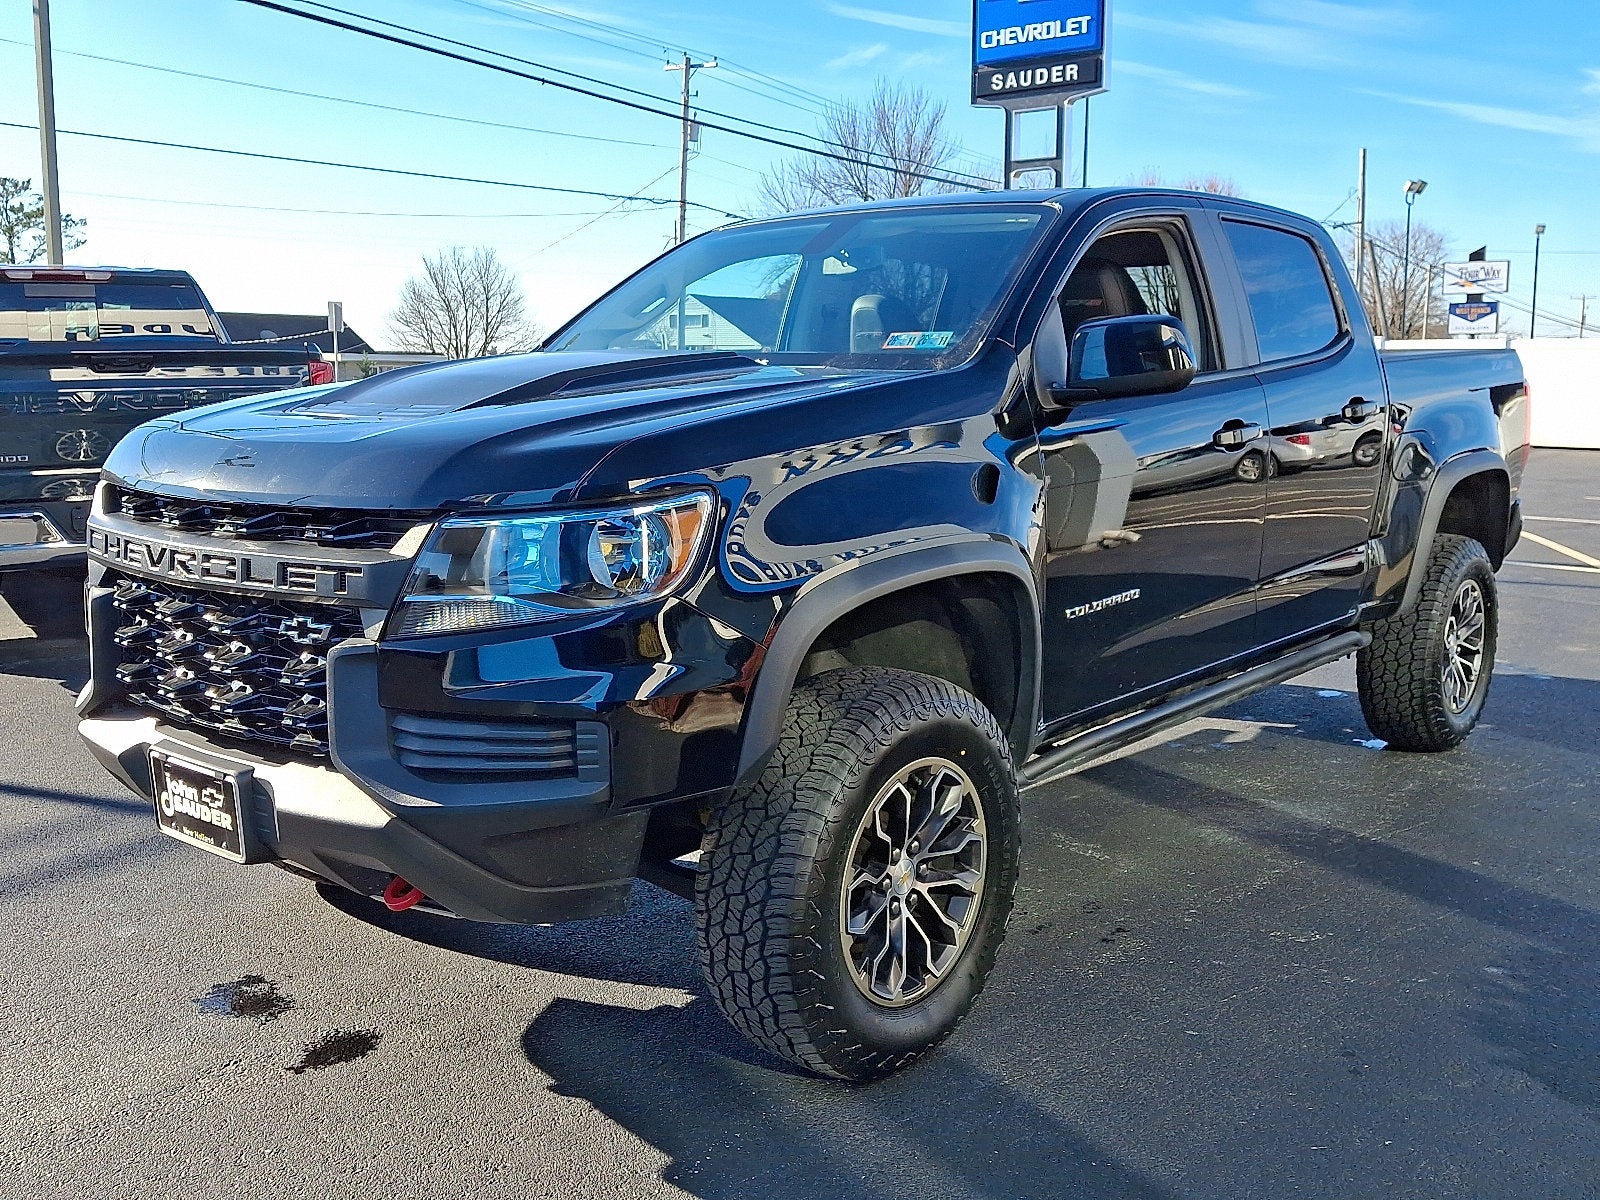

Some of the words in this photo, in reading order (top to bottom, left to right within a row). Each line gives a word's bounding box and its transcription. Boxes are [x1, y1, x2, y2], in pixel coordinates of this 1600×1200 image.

[980, 15, 1092, 49] CHEVROLET
[990, 63, 1079, 91] SAUDER
[89, 529, 364, 594] CHEVROLET
[1065, 588, 1140, 619] COLORADO
